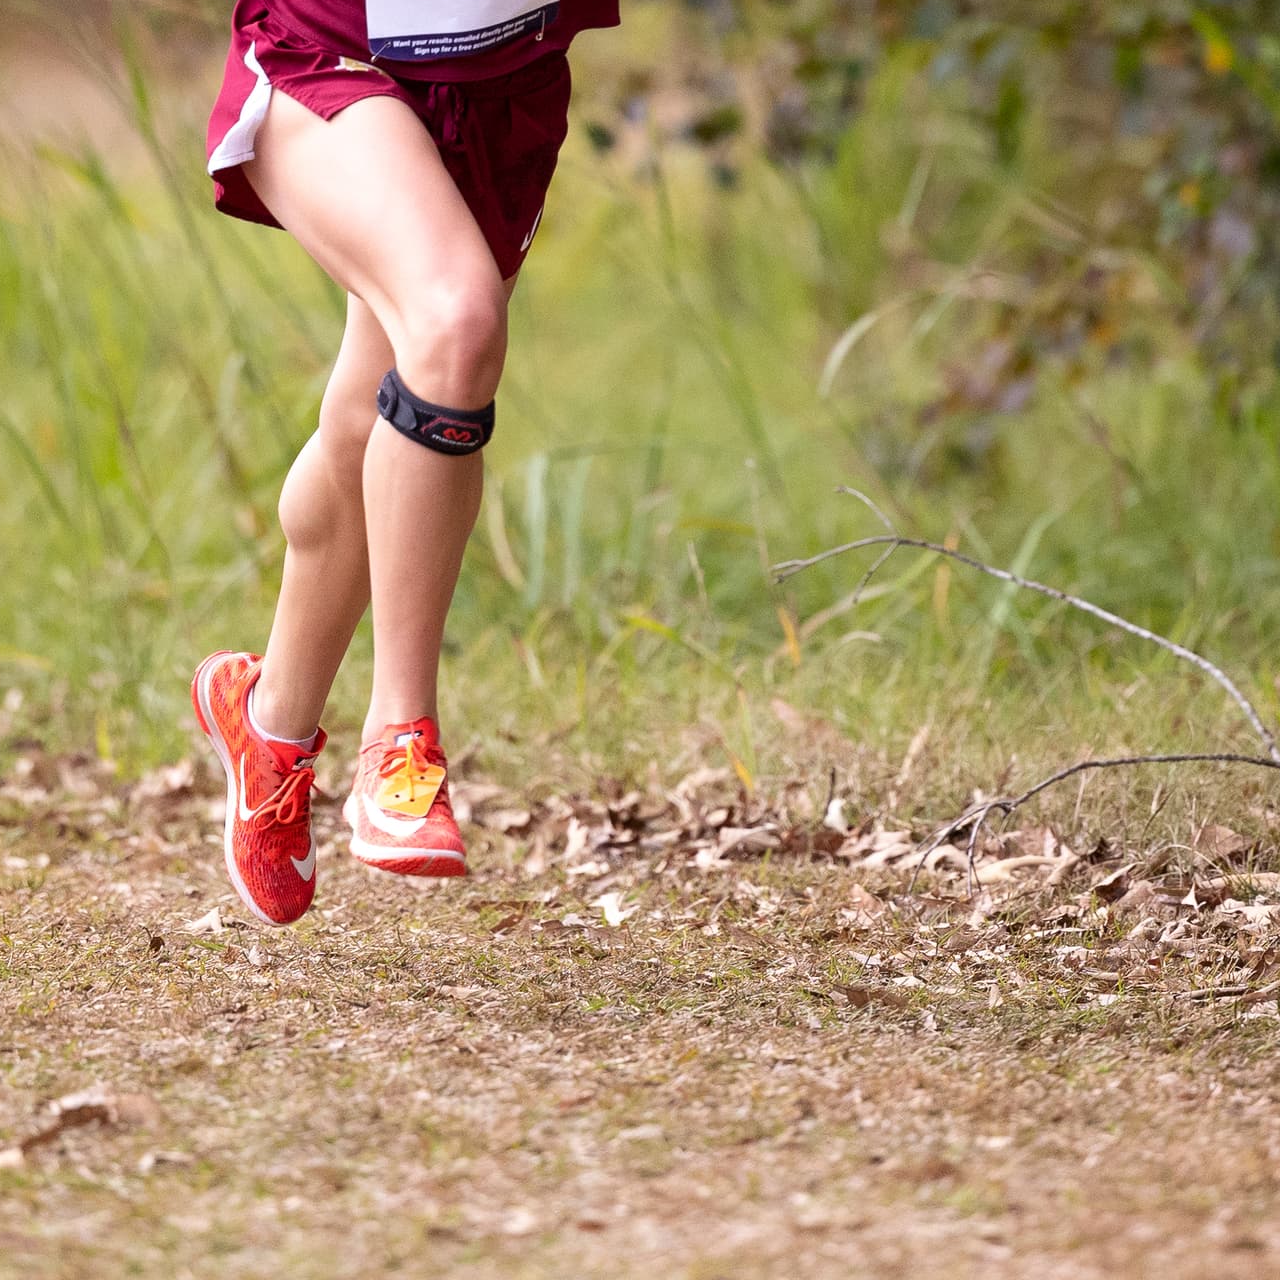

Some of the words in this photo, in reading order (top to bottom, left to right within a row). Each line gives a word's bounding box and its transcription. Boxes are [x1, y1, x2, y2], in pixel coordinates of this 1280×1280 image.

[393, 39, 411, 48] Want
[412, 39, 428, 48] your
[428, 37, 453, 45] results
[454, 33, 480, 44] emailed
[414, 47, 430, 56] Sign
[431, 47, 440, 55] up
[441, 45, 453, 53] for
[458, 43, 473, 52] free
